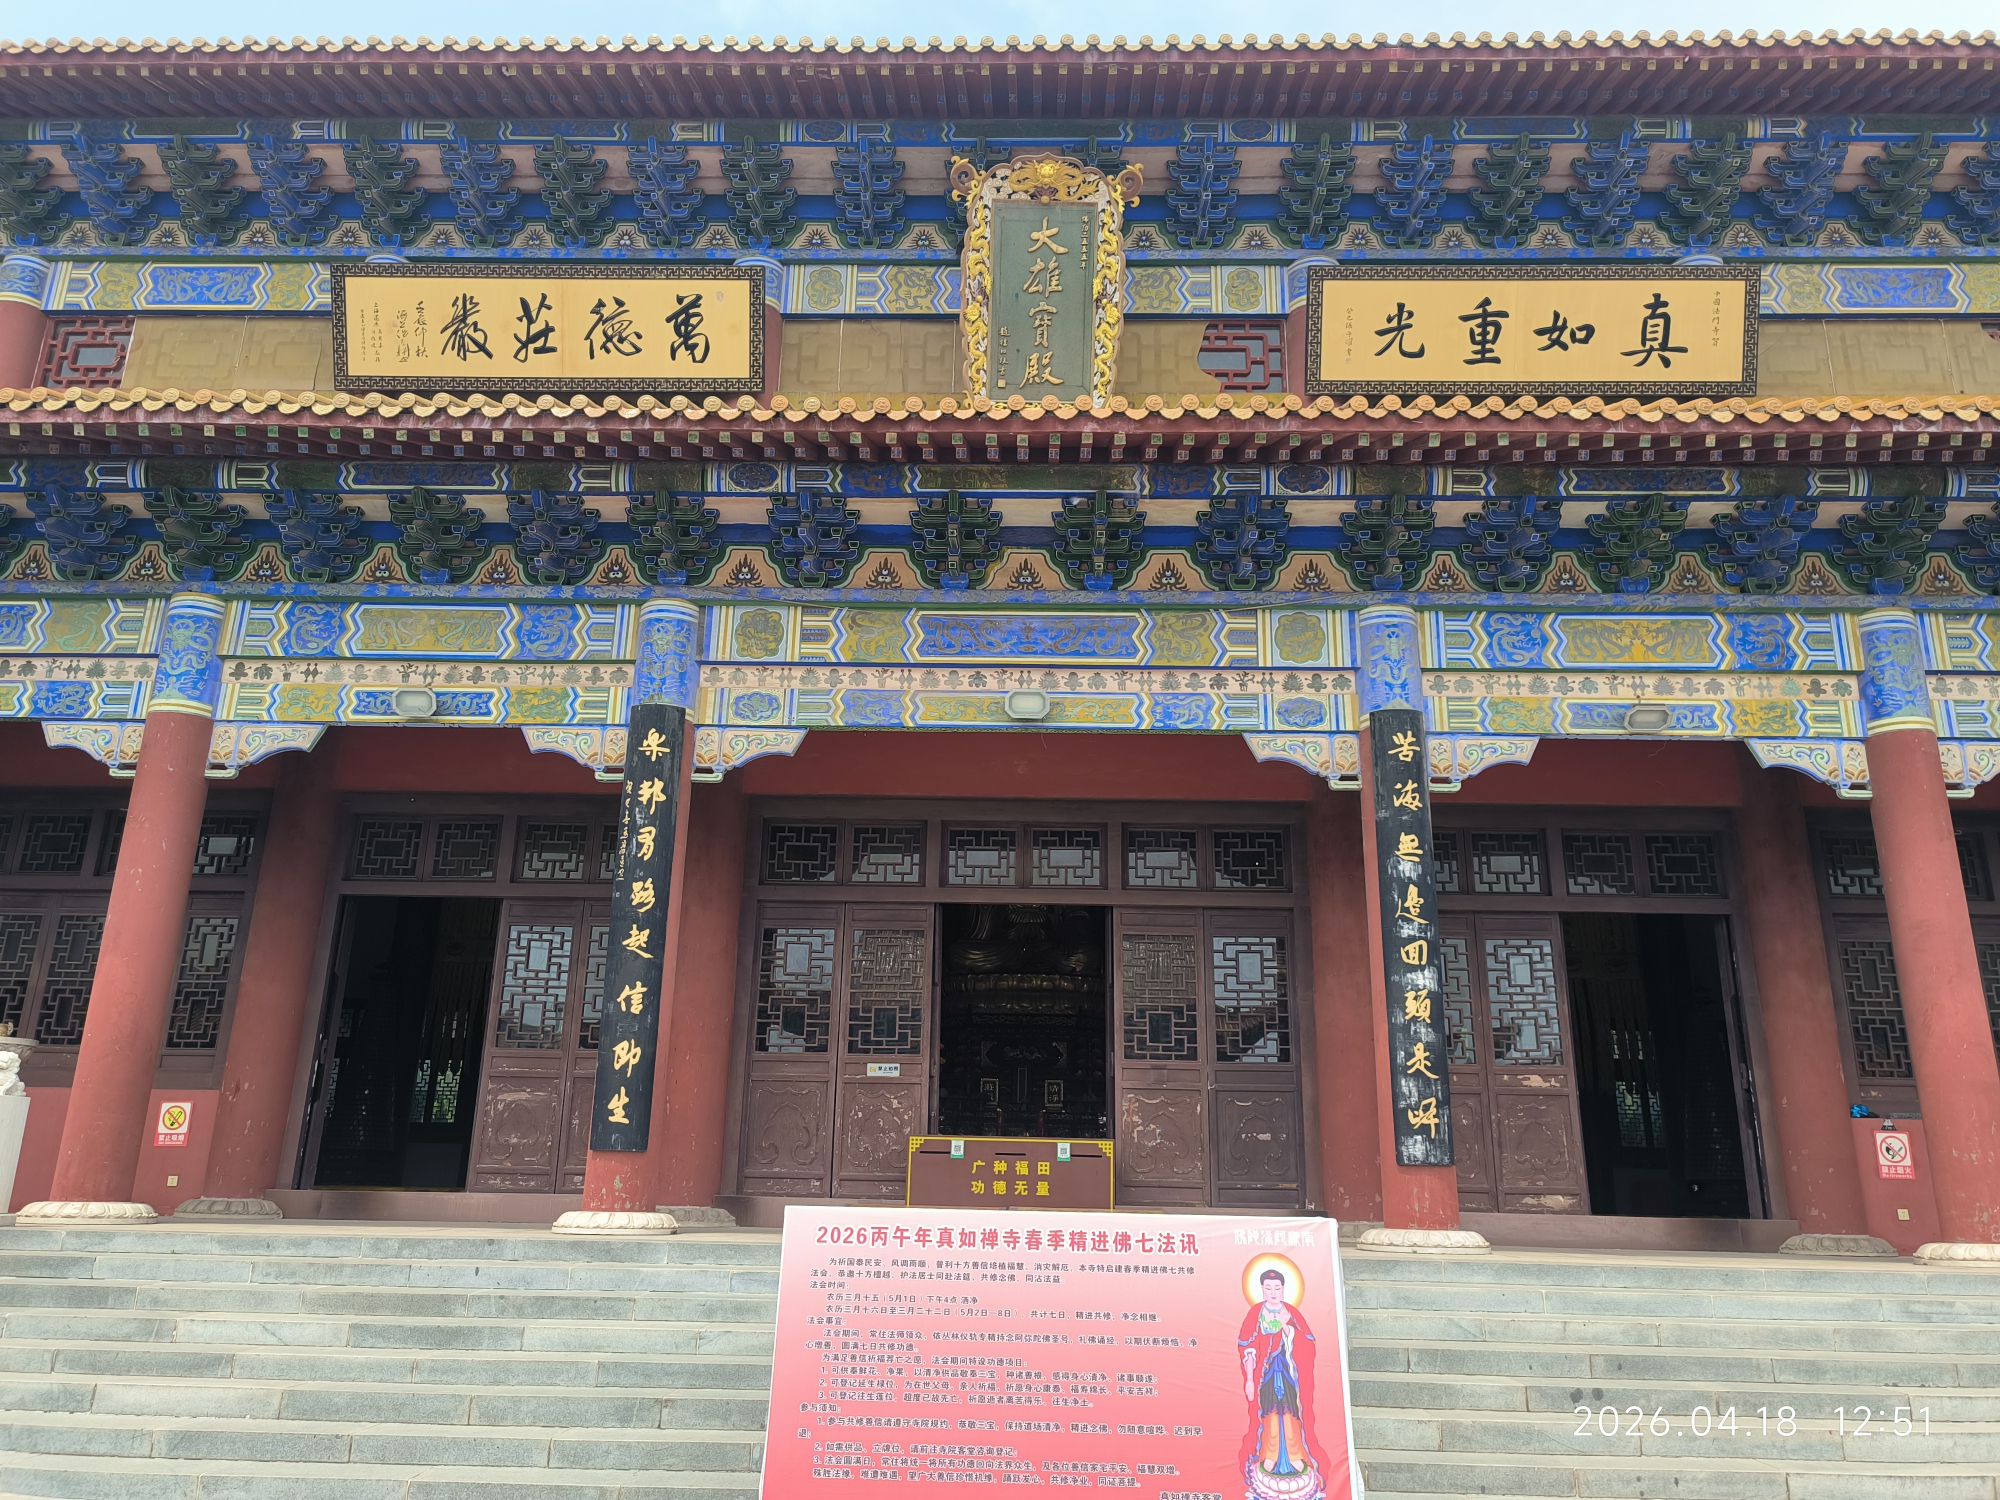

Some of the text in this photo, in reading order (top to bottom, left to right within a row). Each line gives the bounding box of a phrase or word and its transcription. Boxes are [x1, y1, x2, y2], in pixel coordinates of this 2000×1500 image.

[1018, 216, 1069, 390] 大雄寶殿
[971, 1160, 1050, 1176] 广种福田
[971, 1180, 1050, 1196] 功德无量
[816, 1225, 1200, 1256] 2026丙午年真如禅寺春季精进佛七法讯
